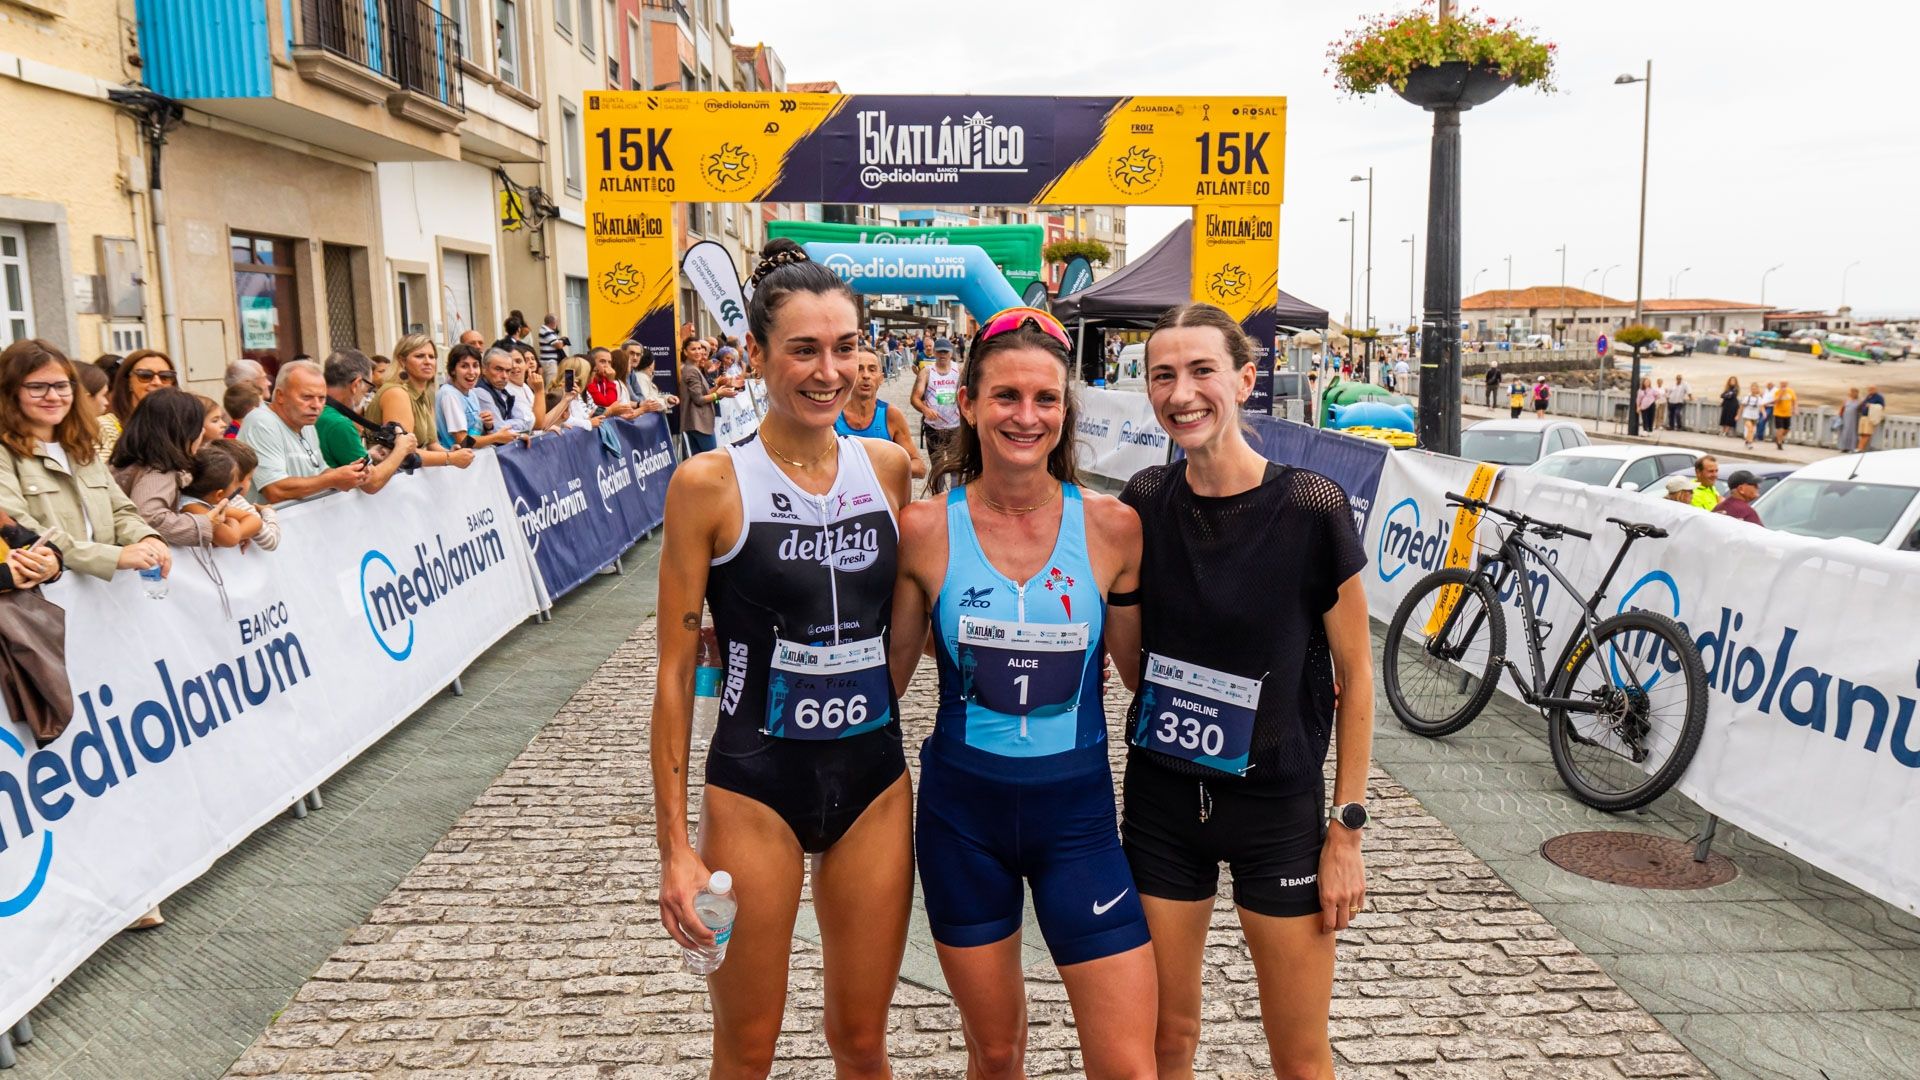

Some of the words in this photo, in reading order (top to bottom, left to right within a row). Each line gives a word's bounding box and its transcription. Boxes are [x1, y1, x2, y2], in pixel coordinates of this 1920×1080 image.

[706, 100, 770, 110] mediolanum
[596, 128, 674, 171] 15K
[1196, 131, 1270, 175] 15K
[865, 169, 958, 183] mediolanum
[830, 258, 965, 279] mediolanum
[518, 490, 588, 537] mediolanum
[1350, 495, 1369, 511] ANCO
[466, 507, 494, 532] BANCO
[779, 522, 880, 561] delikia
[839, 553, 866, 566] fresh
[369, 534, 505, 631] mediolanum
[959, 599, 991, 609] ZICO
[238, 601, 288, 645] BANCO
[721, 640, 748, 716] 226ERS
[1008, 657, 1039, 669] ALICE
[1013, 674, 1029, 705] 1
[795, 694, 868, 729] 666
[1172, 696, 1218, 718] MADELINE
[1156, 711, 1224, 756] 330
